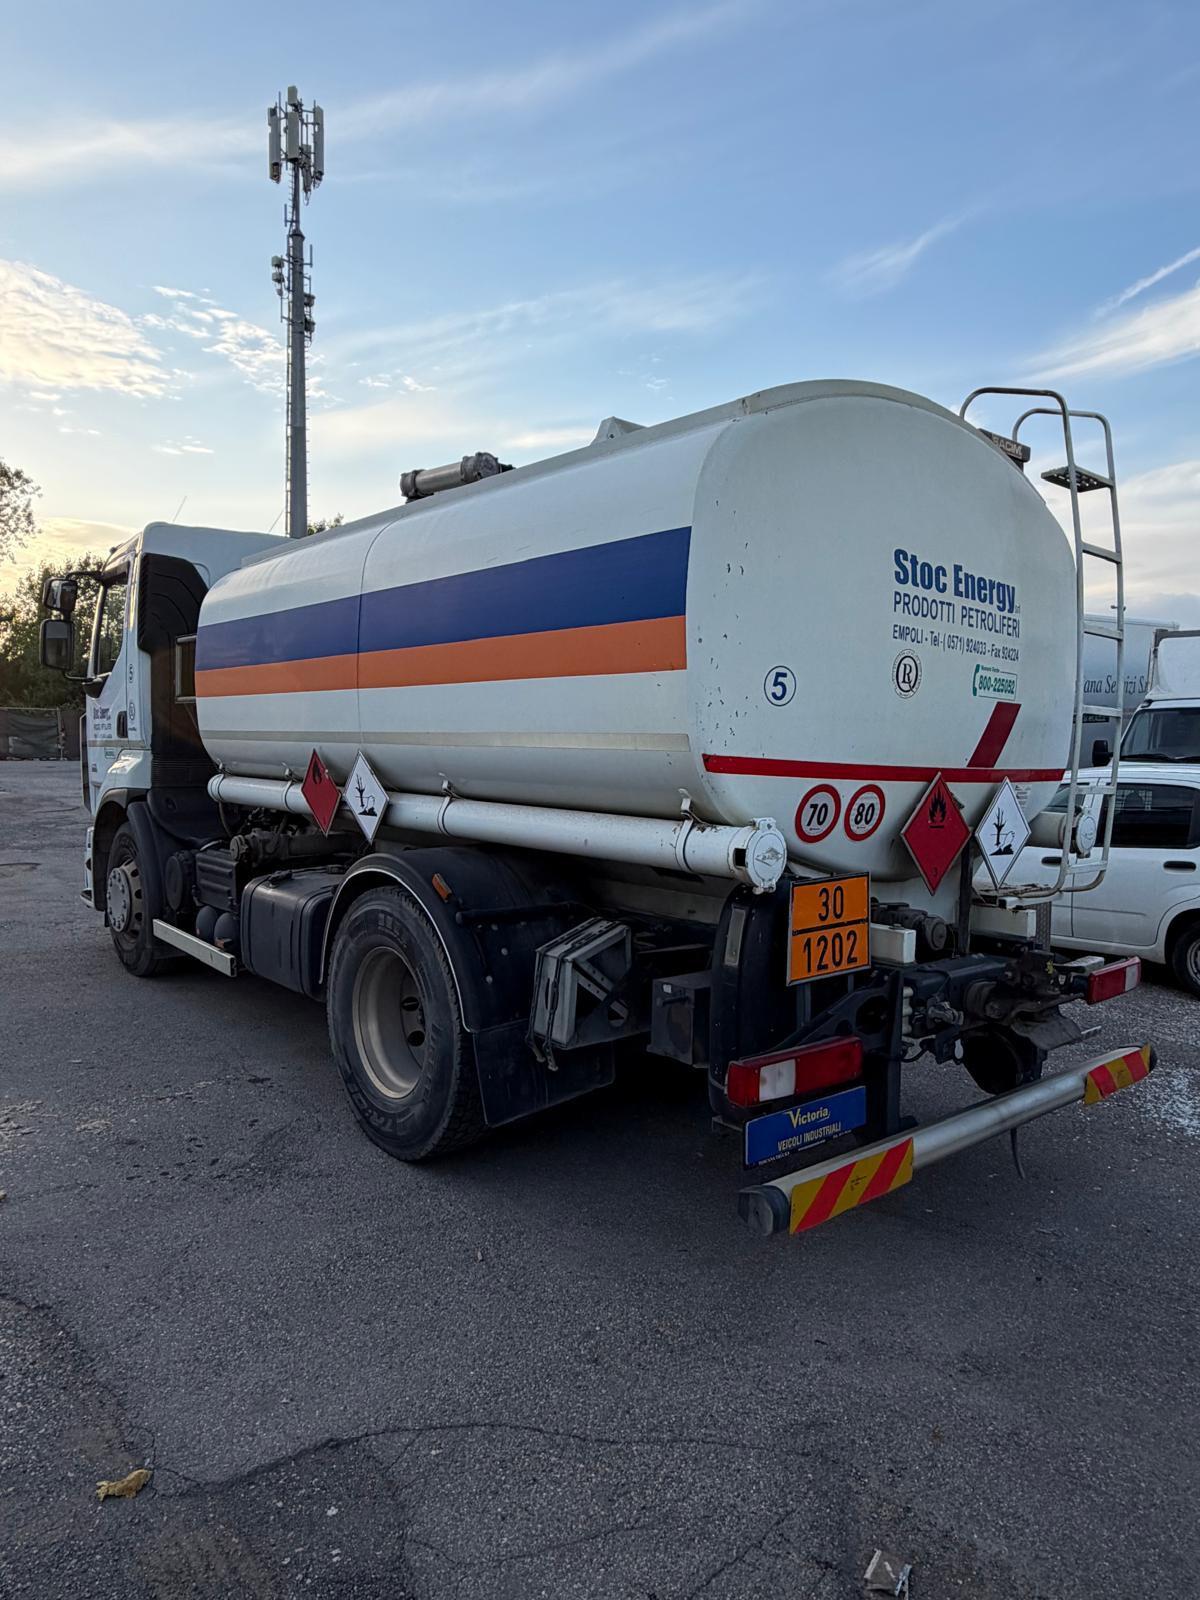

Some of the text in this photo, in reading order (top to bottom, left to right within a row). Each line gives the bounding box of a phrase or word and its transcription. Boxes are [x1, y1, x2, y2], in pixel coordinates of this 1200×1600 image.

[894, 549, 1015, 613] Stoc Energy
[894, 591, 1020, 638] PRODOTTI PETROLIFERI
[893, 624, 923, 644] EMPOLI
[966, 638, 987, 656] 924033
[771, 672, 788, 701] 5
[978, 675, 1015, 695] 800-225052
[1083, 679, 1103, 694] ana
[806, 803, 829, 827] 70
[854, 802, 875, 826] 80
[818, 885, 844, 922] 30
[803, 929, 858, 973] 1202
[784, 1106, 830, 1129] Victoria
[778, 1135, 802, 1152] VEICOLI
[804, 1121, 841, 1143] INDUSTRIALI
